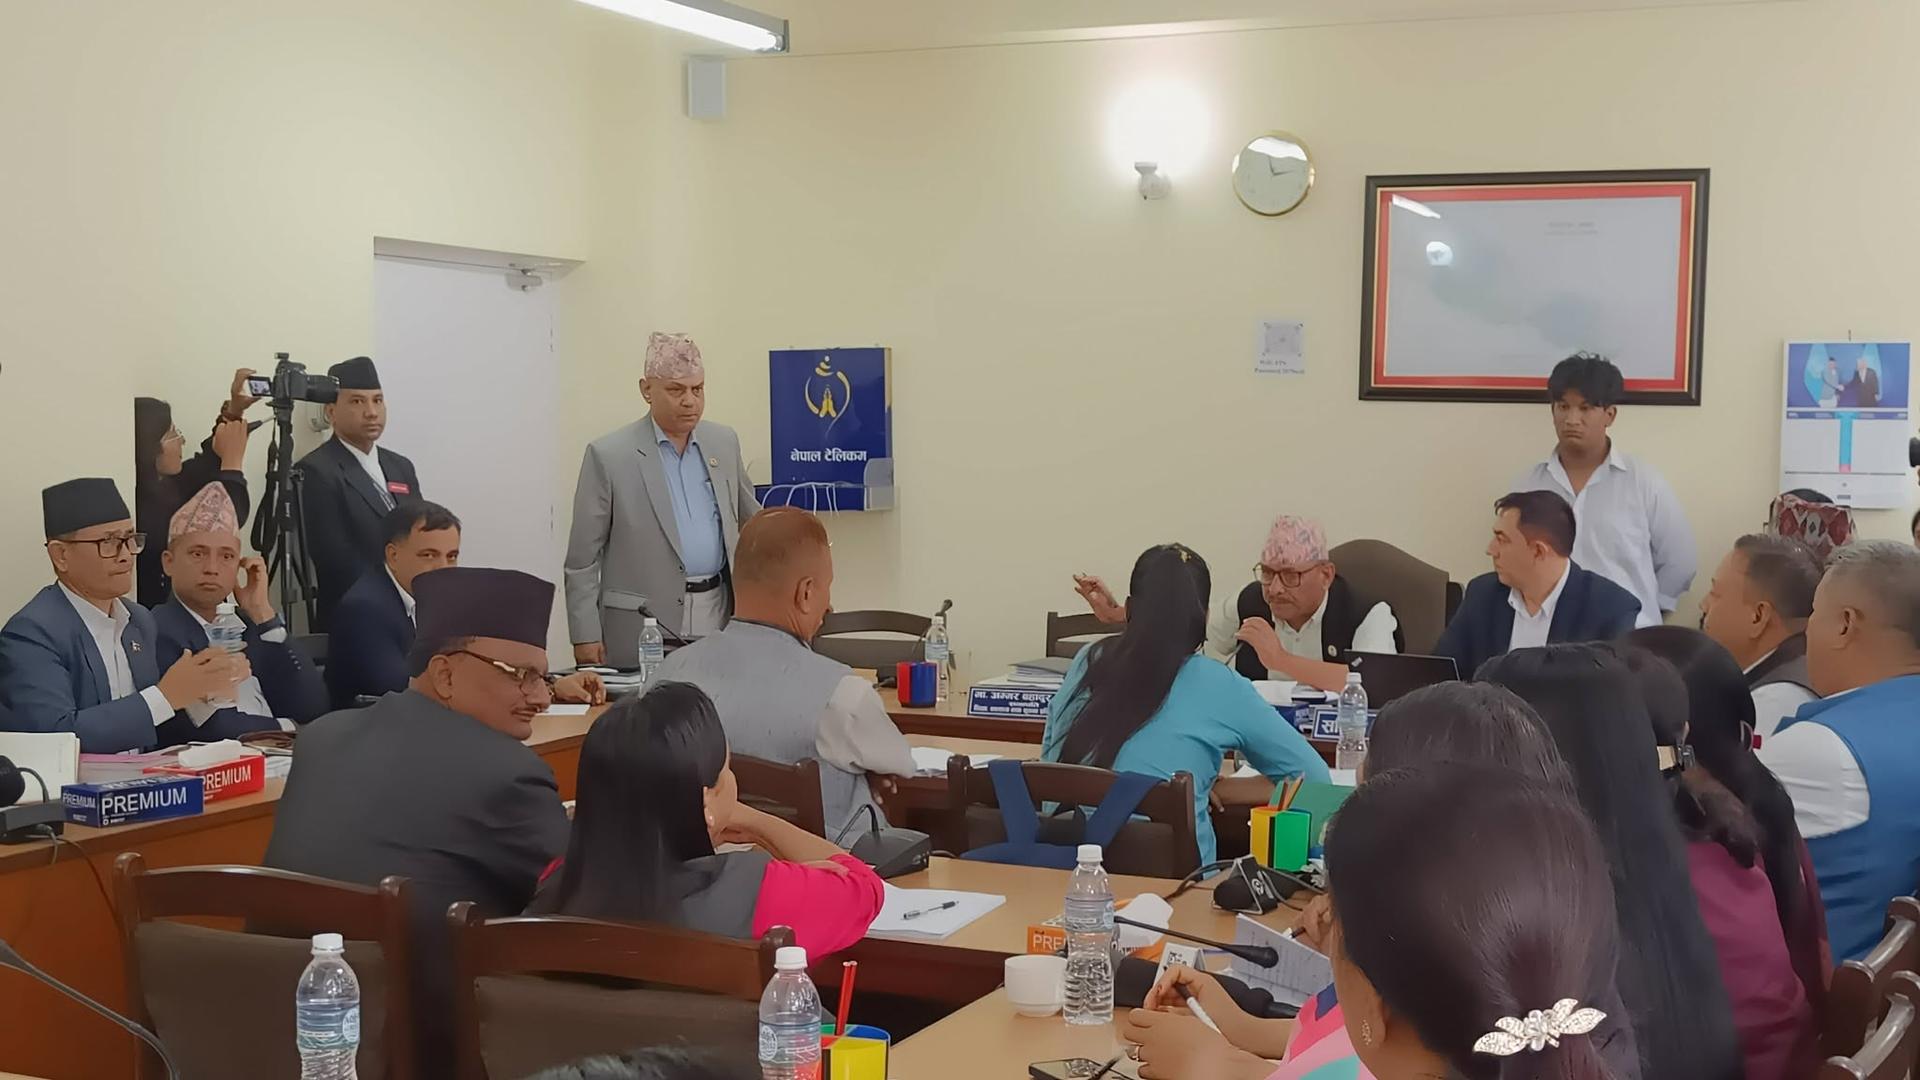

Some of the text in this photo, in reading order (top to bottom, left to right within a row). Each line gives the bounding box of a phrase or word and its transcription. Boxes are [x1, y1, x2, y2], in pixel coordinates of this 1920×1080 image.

[790, 447, 867, 462] नेपाल टेलिकम
[62, 793, 96, 808] PREMIUM
[101, 786, 187, 816] PREMIUM
[1032, 934, 1067, 952] PRE
